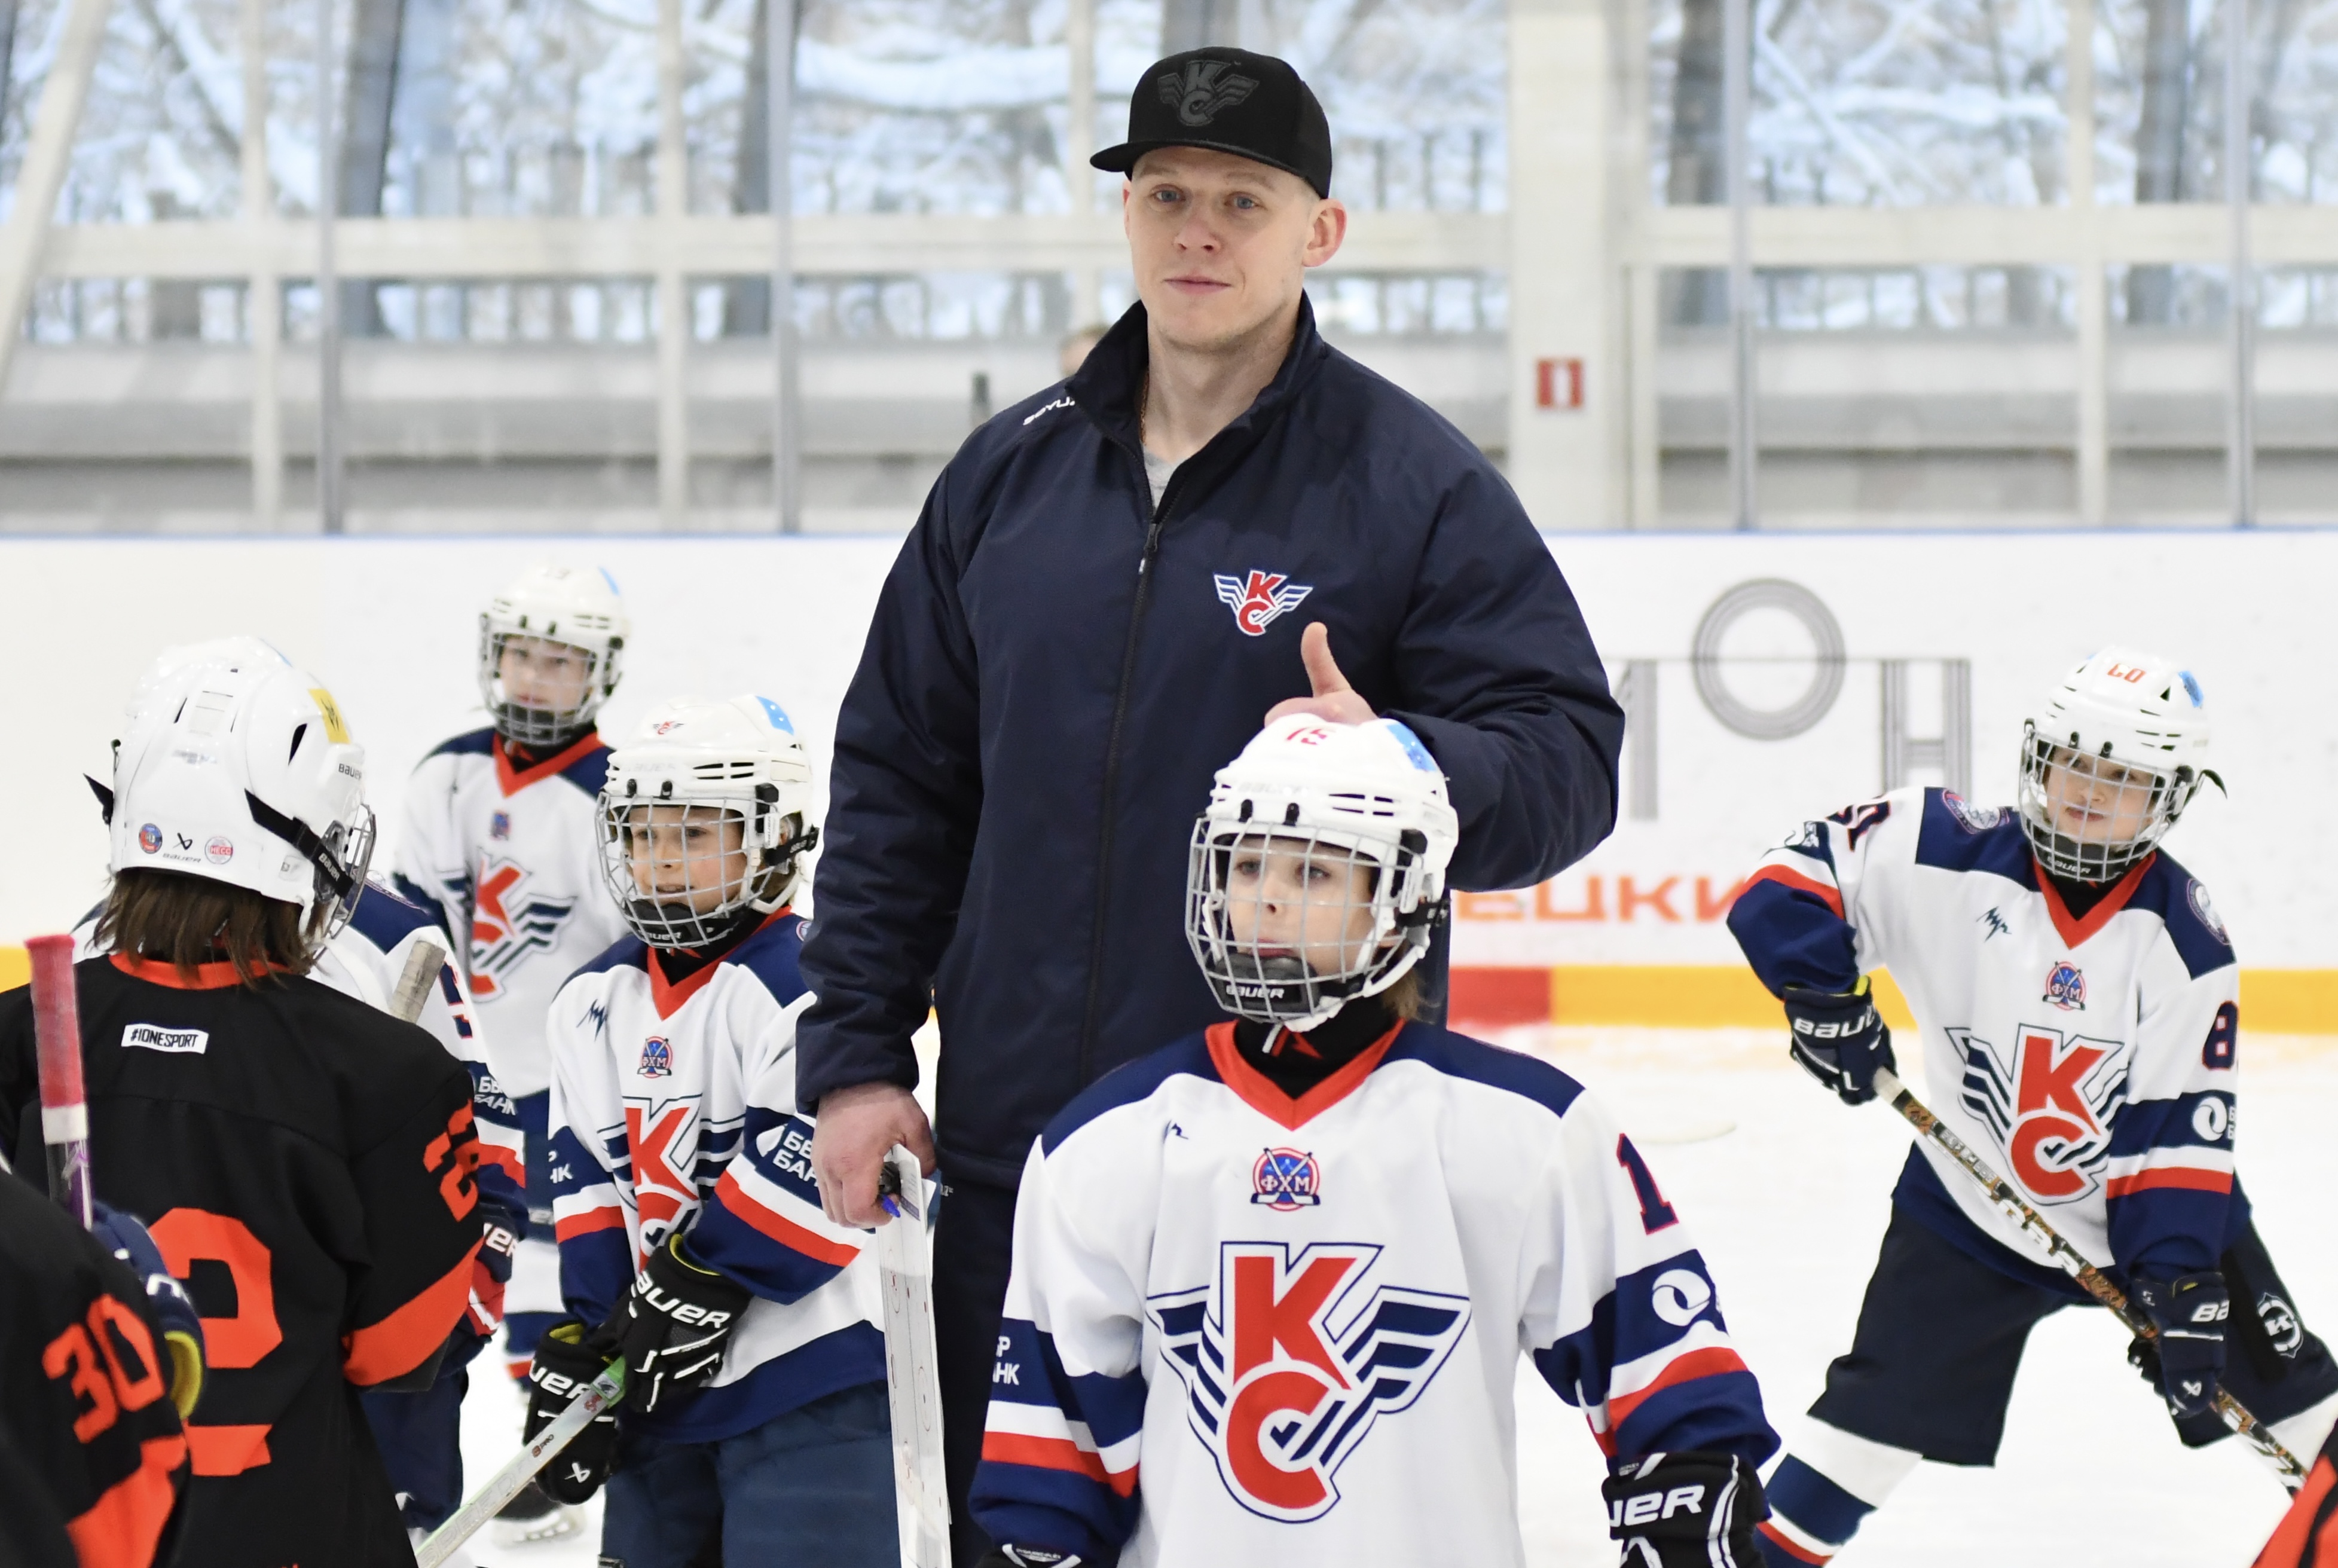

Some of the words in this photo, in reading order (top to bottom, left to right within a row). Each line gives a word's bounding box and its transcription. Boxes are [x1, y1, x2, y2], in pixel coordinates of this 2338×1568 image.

[1260, 1174, 1310, 1192] ФХМ
[629, 1270, 731, 1328] AUER
[43, 1294, 164, 1443] 30
